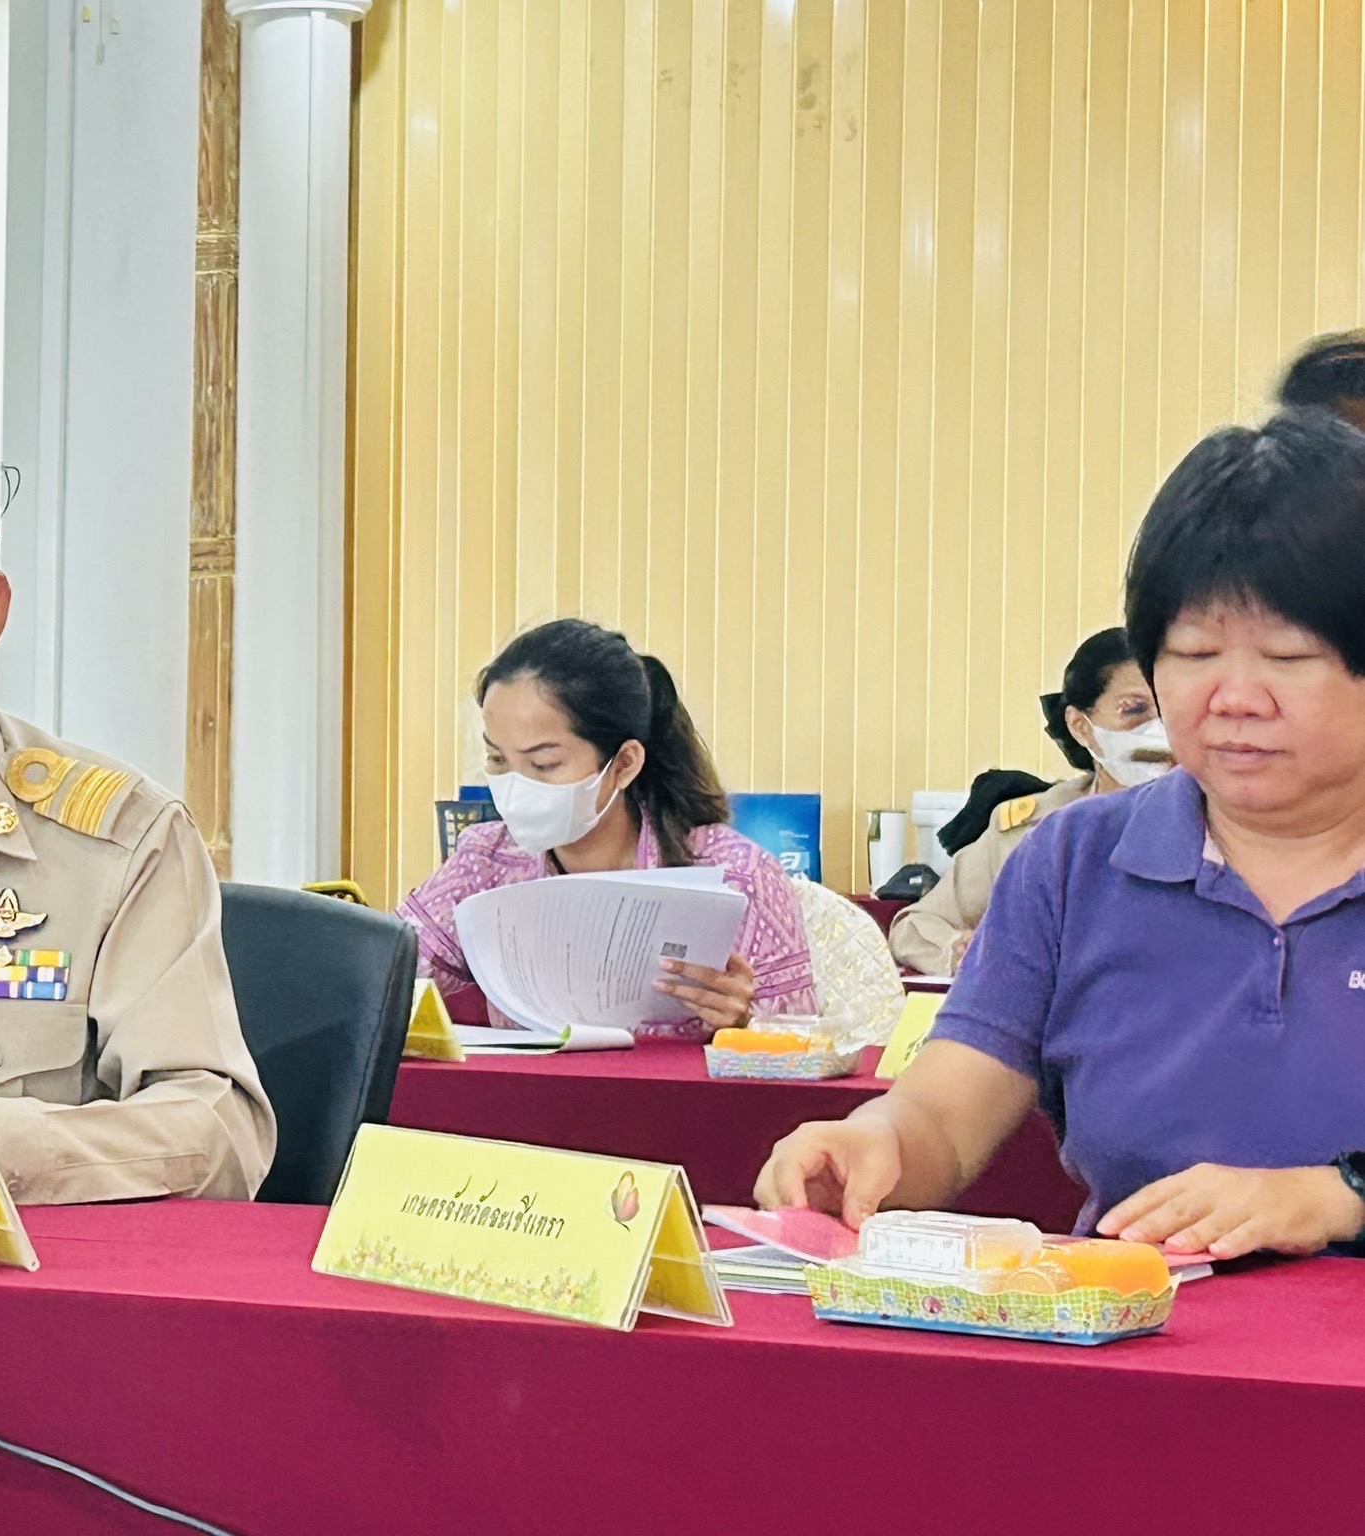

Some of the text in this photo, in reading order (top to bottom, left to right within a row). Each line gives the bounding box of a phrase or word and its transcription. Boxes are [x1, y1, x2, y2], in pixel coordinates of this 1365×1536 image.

[400, 1175, 565, 1239] เกษตรจังหวัดฉะเชิงเทรา
